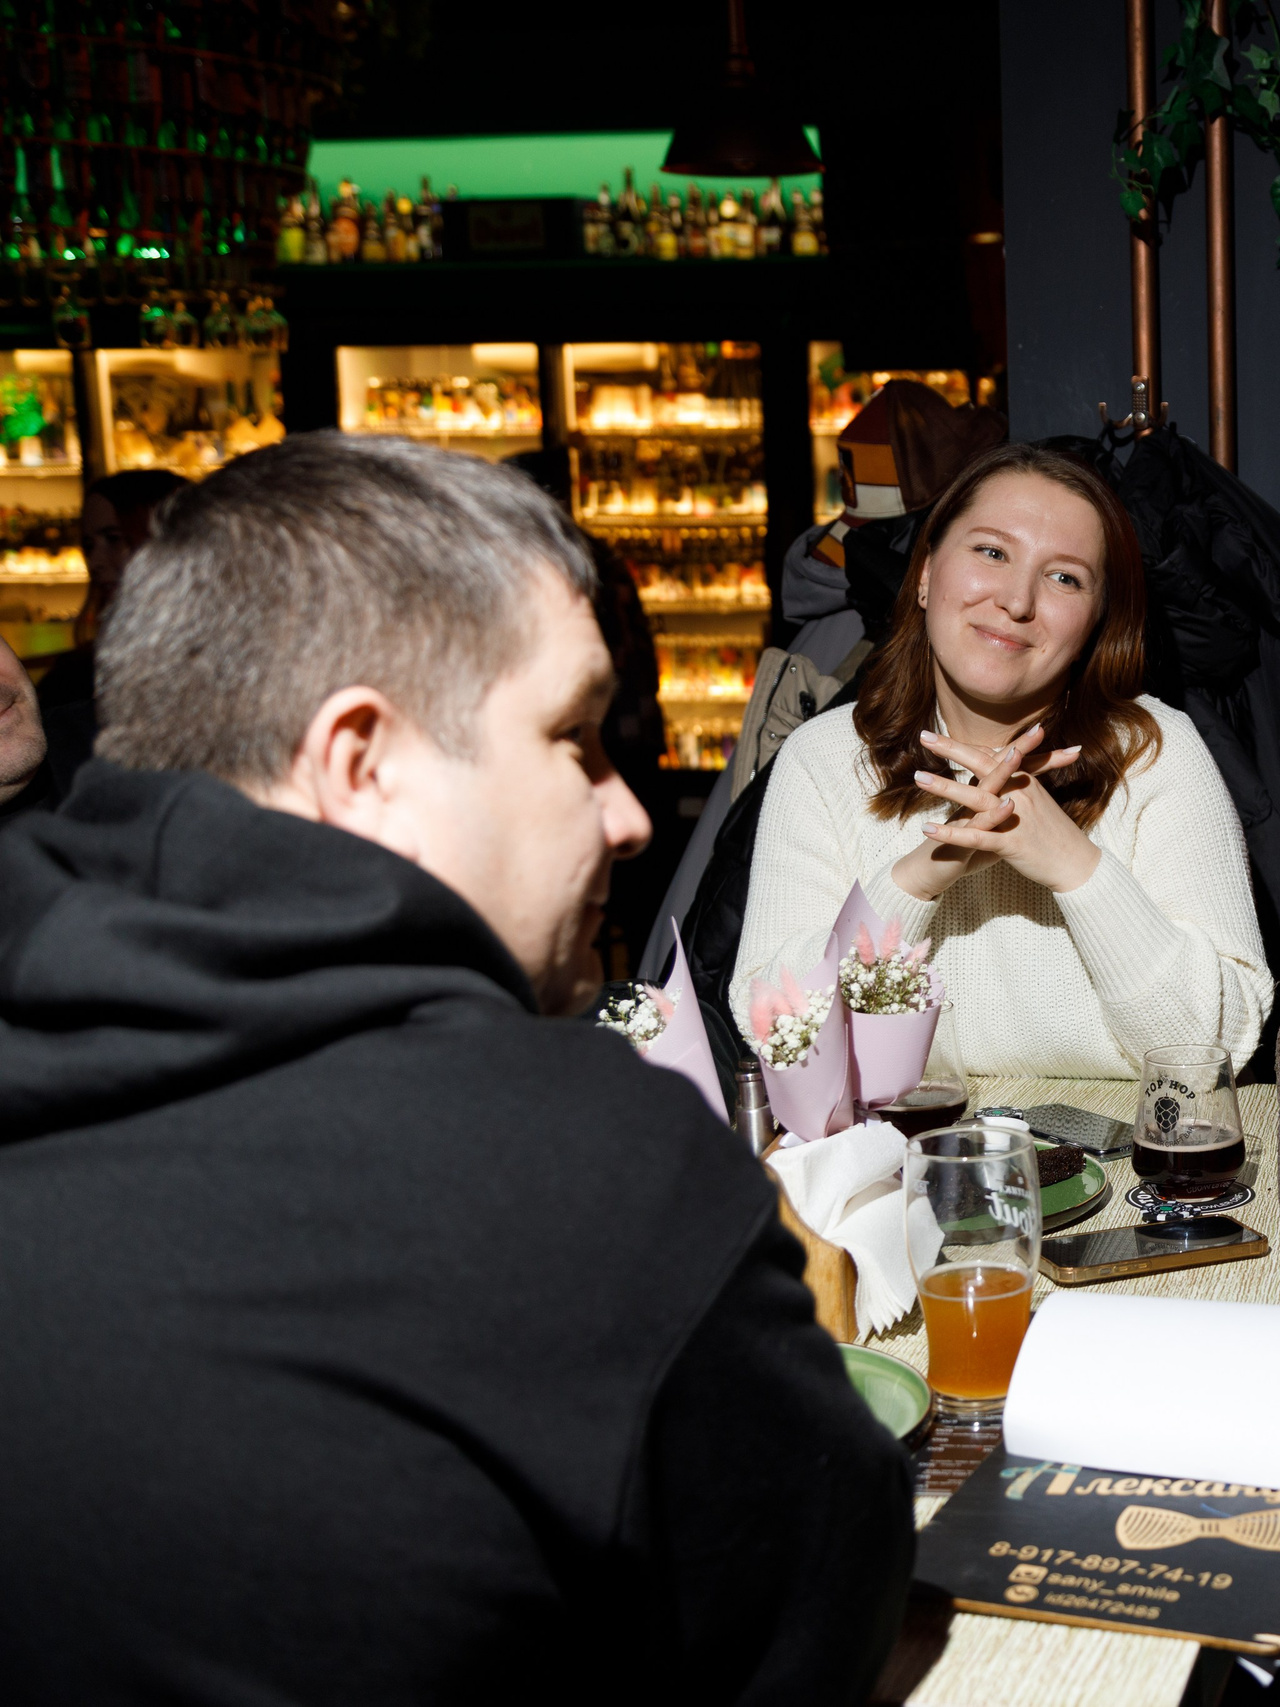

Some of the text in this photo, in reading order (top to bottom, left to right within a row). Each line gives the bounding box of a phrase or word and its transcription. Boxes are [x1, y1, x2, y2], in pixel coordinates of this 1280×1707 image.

[1145, 1080, 1196, 1100] TOP HOP
[988, 1540, 1234, 1590] 8-917-897-74-19
